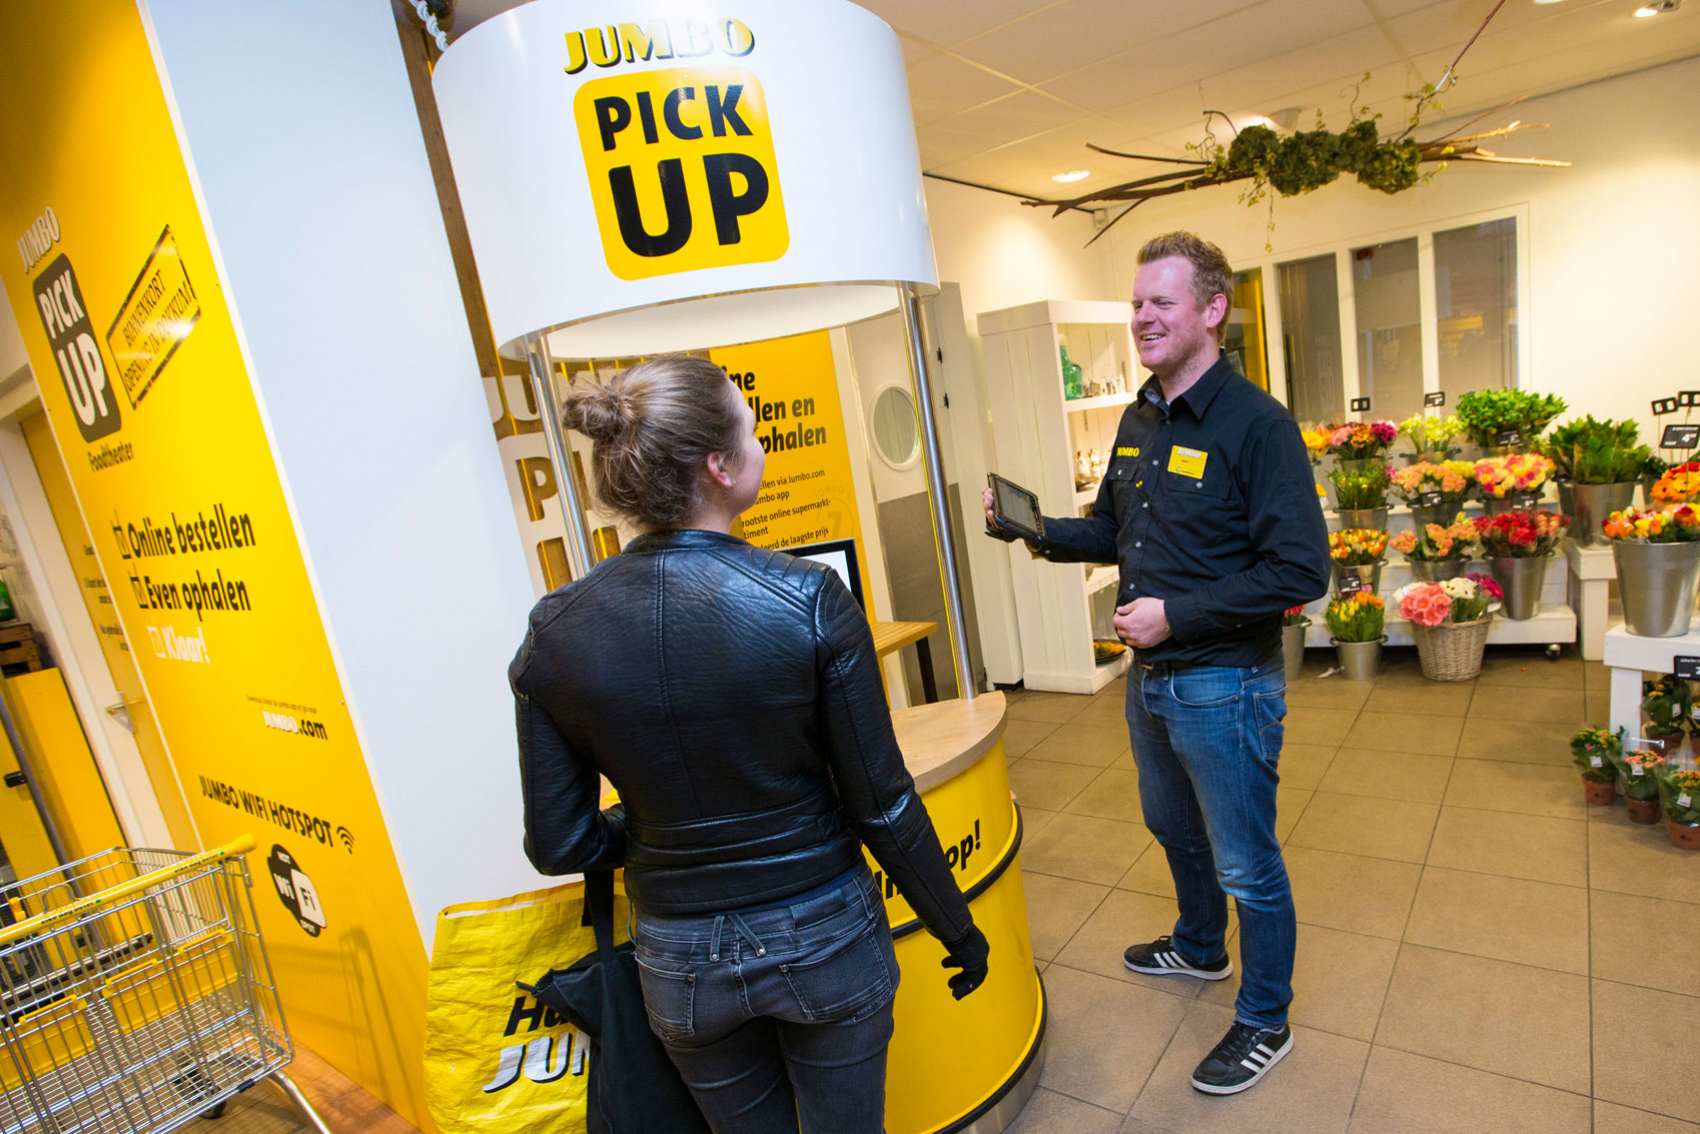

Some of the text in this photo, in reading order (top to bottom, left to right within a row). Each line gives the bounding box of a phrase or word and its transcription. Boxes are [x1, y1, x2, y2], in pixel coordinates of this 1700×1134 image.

[563, 17, 755, 74] JUMBO
[594, 84, 754, 151] PICK
[608, 152, 770, 257] UP
[16, 206, 61, 274] JUMBO
[38, 269, 85, 339] PICK
[57, 332, 107, 427] UP
[792, 398, 815, 417] en
[776, 490, 790, 501] app
[777, 475, 787, 486] via
[128, 503, 256, 558] Online bestellen
[769, 508, 790, 520] online
[781, 537, 789, 547] de
[790, 531, 814, 544] laagste
[815, 526, 829, 539] prijs
[144, 568, 251, 622] Even ophalen
[161, 624, 211, 665] Klaar!
[199, 775, 333, 848] JUMBO WIFI HOTSPOT
